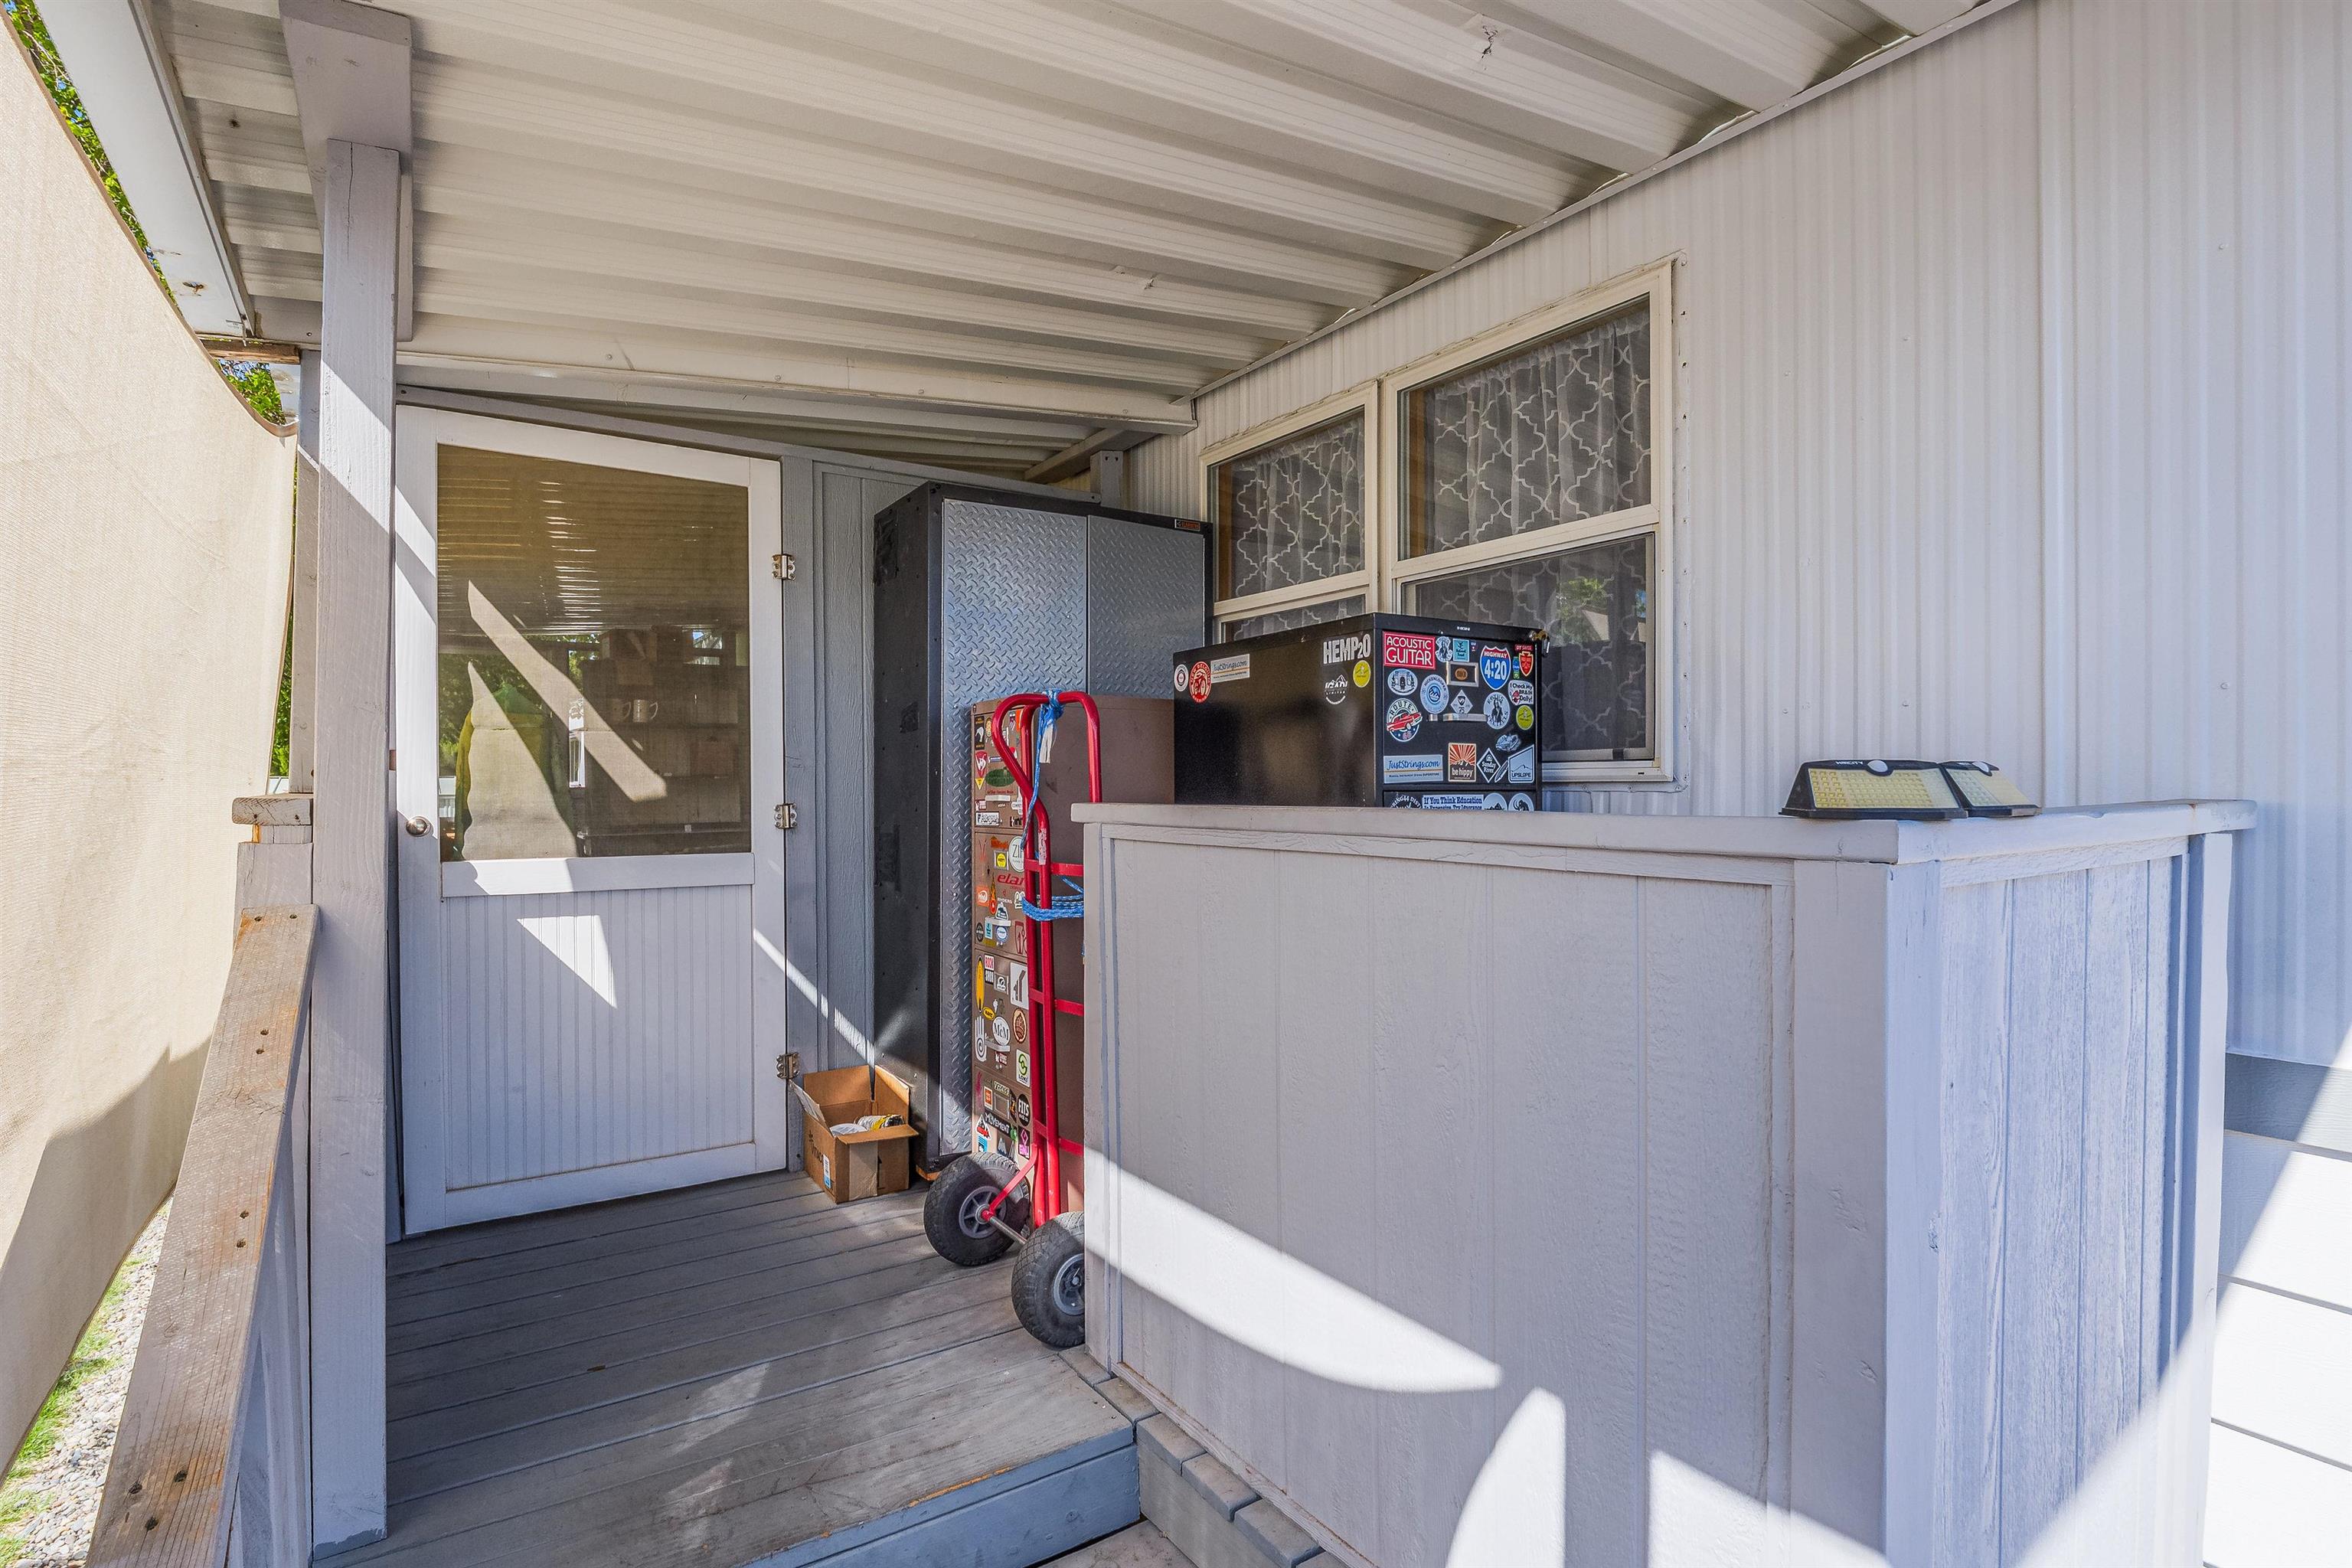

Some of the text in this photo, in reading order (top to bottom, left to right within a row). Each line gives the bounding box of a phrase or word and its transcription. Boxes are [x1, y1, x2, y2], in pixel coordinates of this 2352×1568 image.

[1387, 636, 1431, 650] ACOUSTIC
[1387, 647, 1432, 665] GUITAR
[1485, 659, 1508, 681] 4:20
[1390, 701, 1413, 717] ROUTE
[1387, 760, 1439, 770] JustStrings.com
[1452, 767, 1473, 777] be hippy
[1481, 761, 1496, 769] Sunday
[1018, 1099, 1029, 1116] FITS
[985, 1112, 1010, 1134] MOVEMENT
